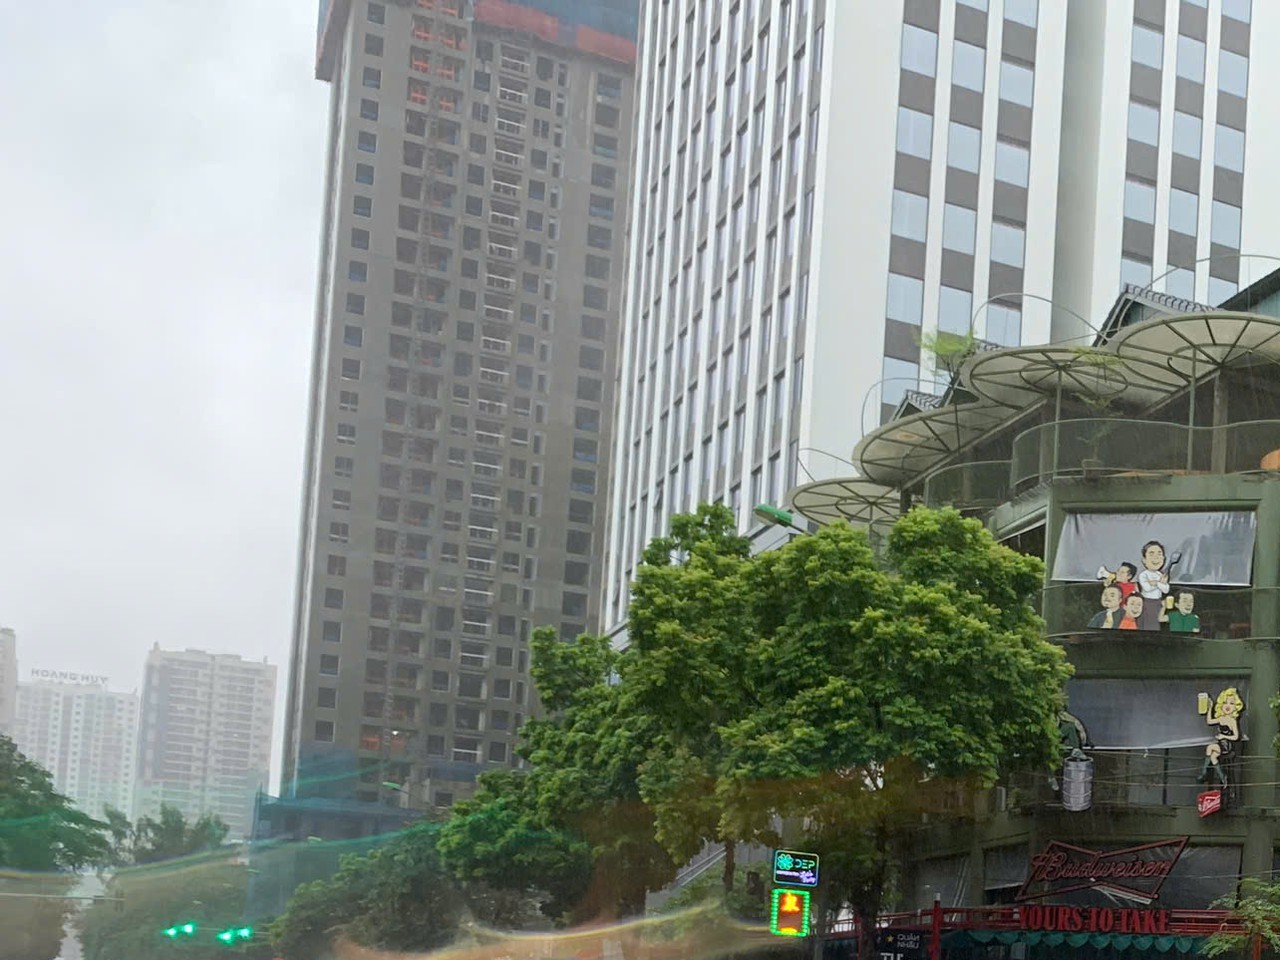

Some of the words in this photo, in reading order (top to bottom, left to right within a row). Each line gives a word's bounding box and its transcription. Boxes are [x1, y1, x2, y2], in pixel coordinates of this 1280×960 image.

[1031, 852, 1172, 881] Budweiser
[1019, 905, 1083, 931] YOURS
[1087, 907, 1114, 932] TO
[1118, 908, 1170, 934] TAKE
